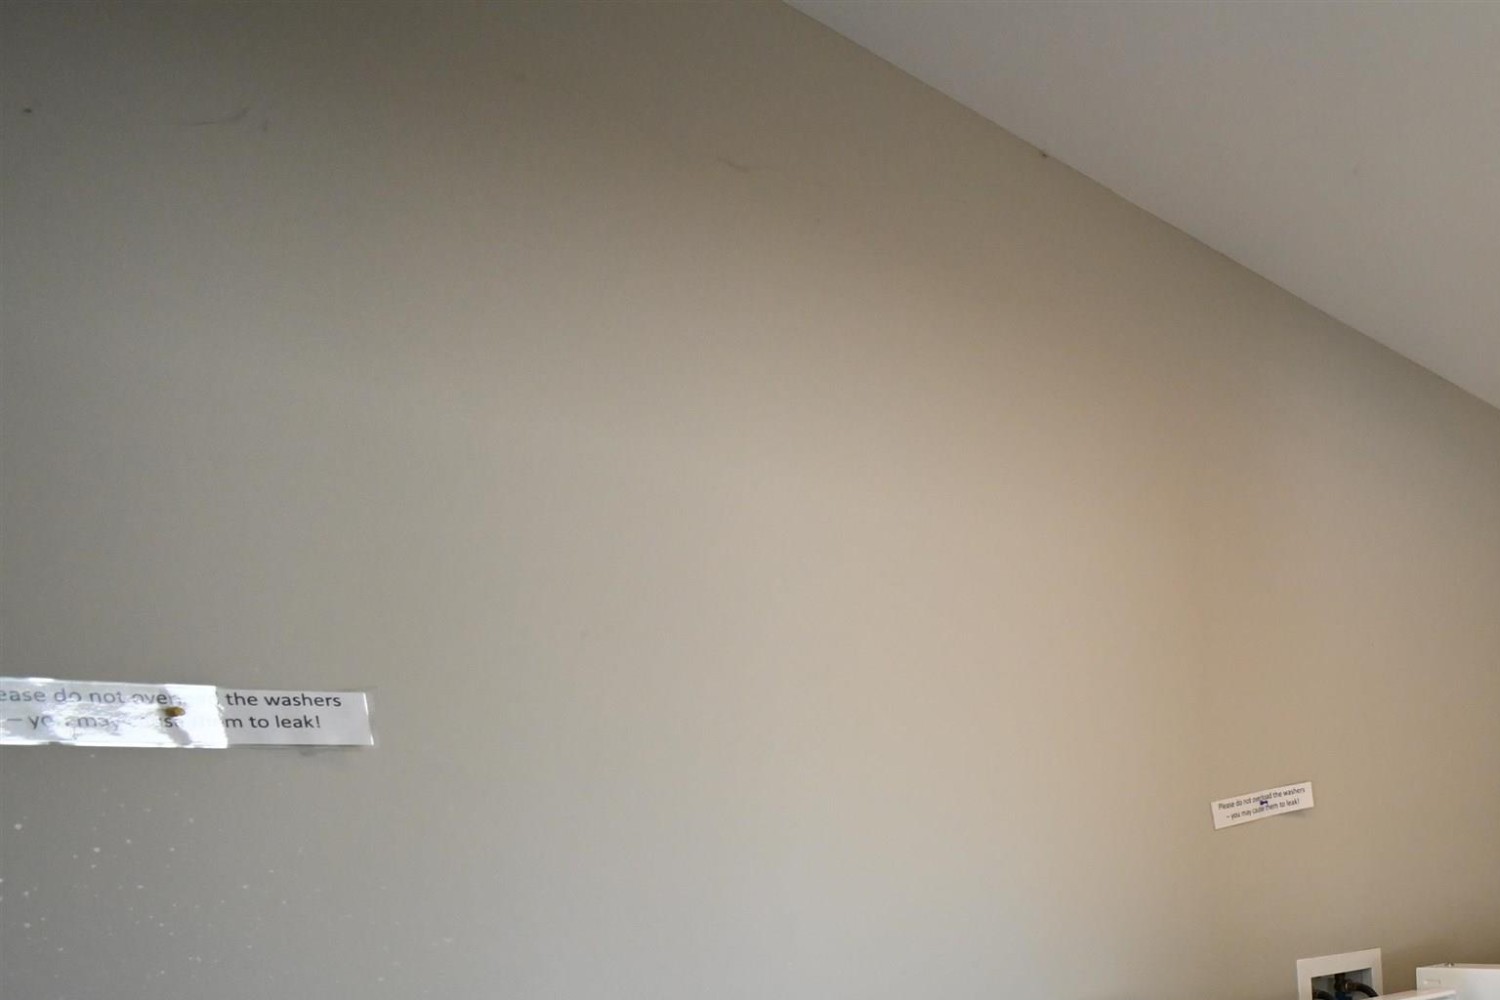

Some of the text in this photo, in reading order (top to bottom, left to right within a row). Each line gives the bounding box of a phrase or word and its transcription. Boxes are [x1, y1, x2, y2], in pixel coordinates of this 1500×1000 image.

[54, 687, 82, 702] do
[89, 690, 124, 704] not
[226, 691, 260, 706] the
[264, 693, 342, 707] washers
[250, 716, 270, 729] to
[275, 714, 321, 729] leak!
